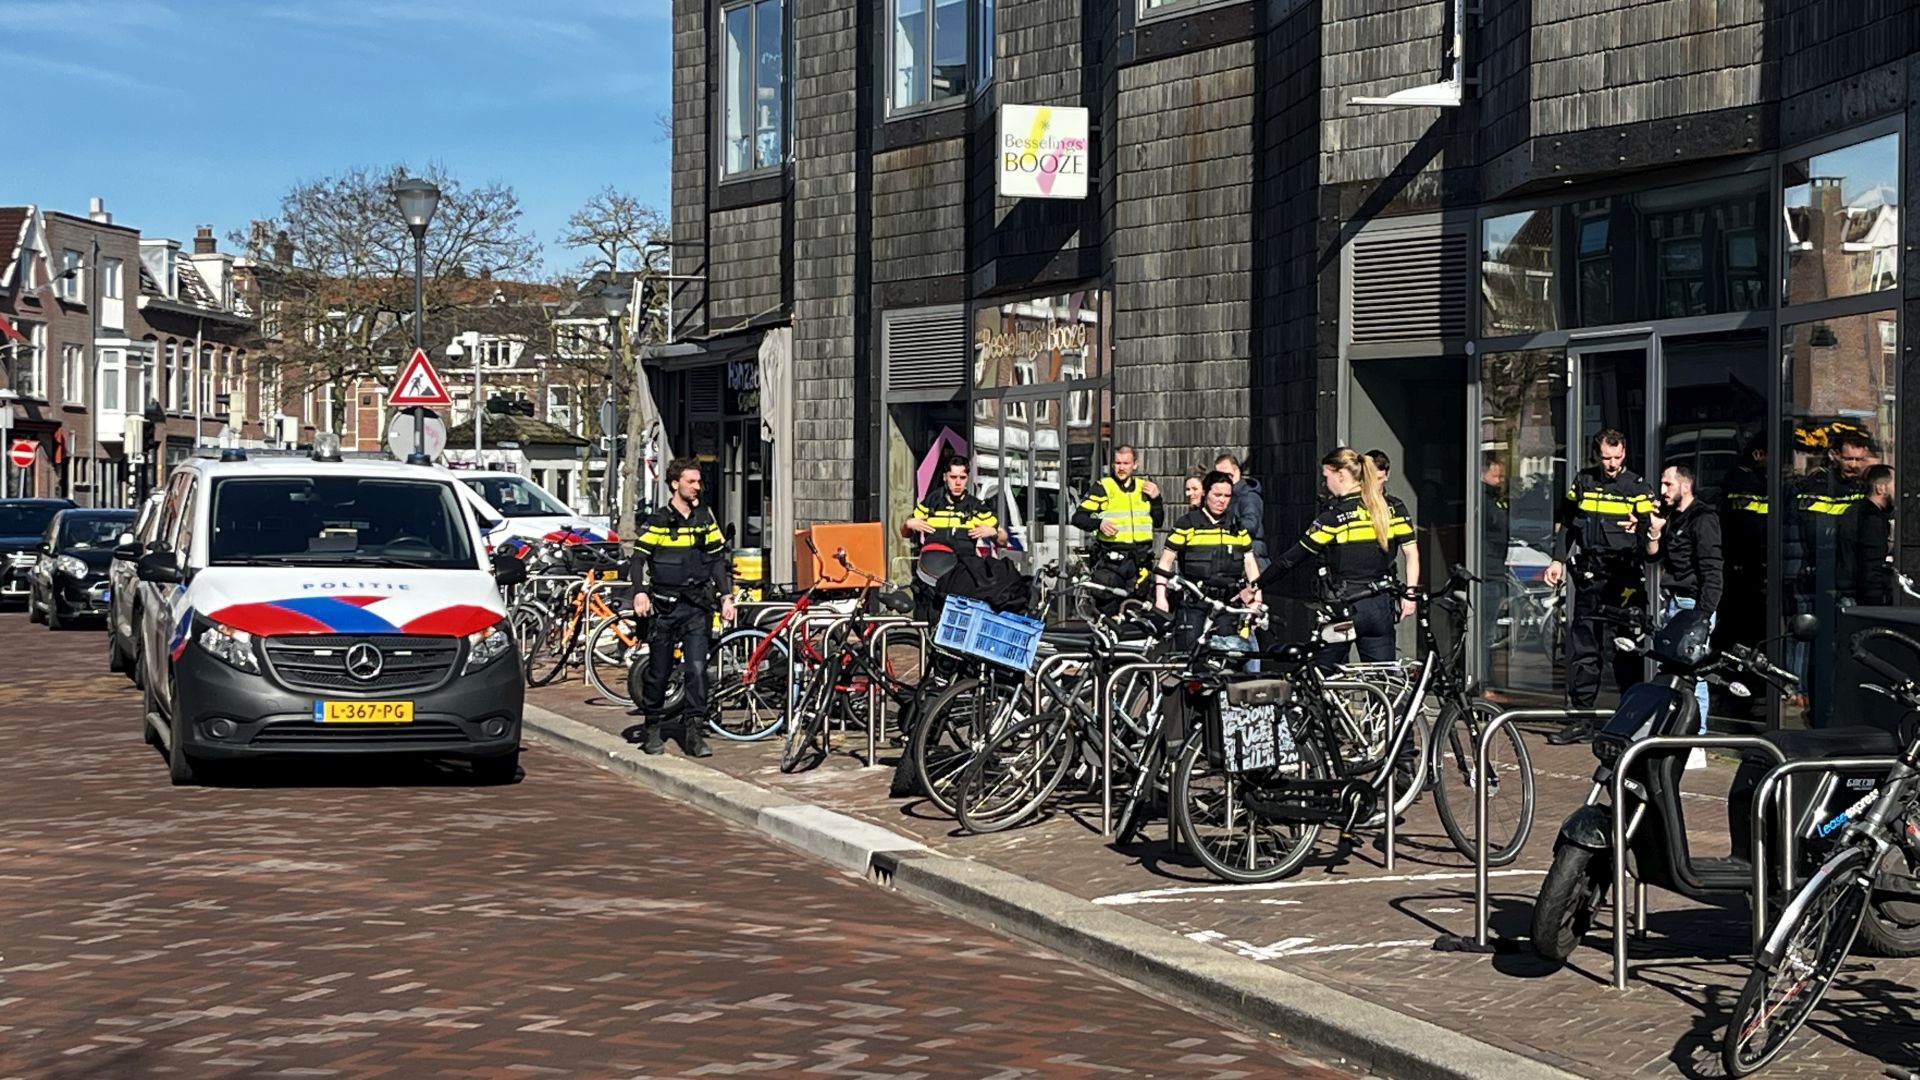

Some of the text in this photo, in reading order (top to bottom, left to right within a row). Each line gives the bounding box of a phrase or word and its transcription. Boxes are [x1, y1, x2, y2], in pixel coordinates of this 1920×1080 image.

[1005, 152, 1085, 175] BOOZE
[1047, 316, 1086, 351] Booze
[302, 581, 410, 590] POLITIE
[331, 704, 405, 719] L-367-PG
